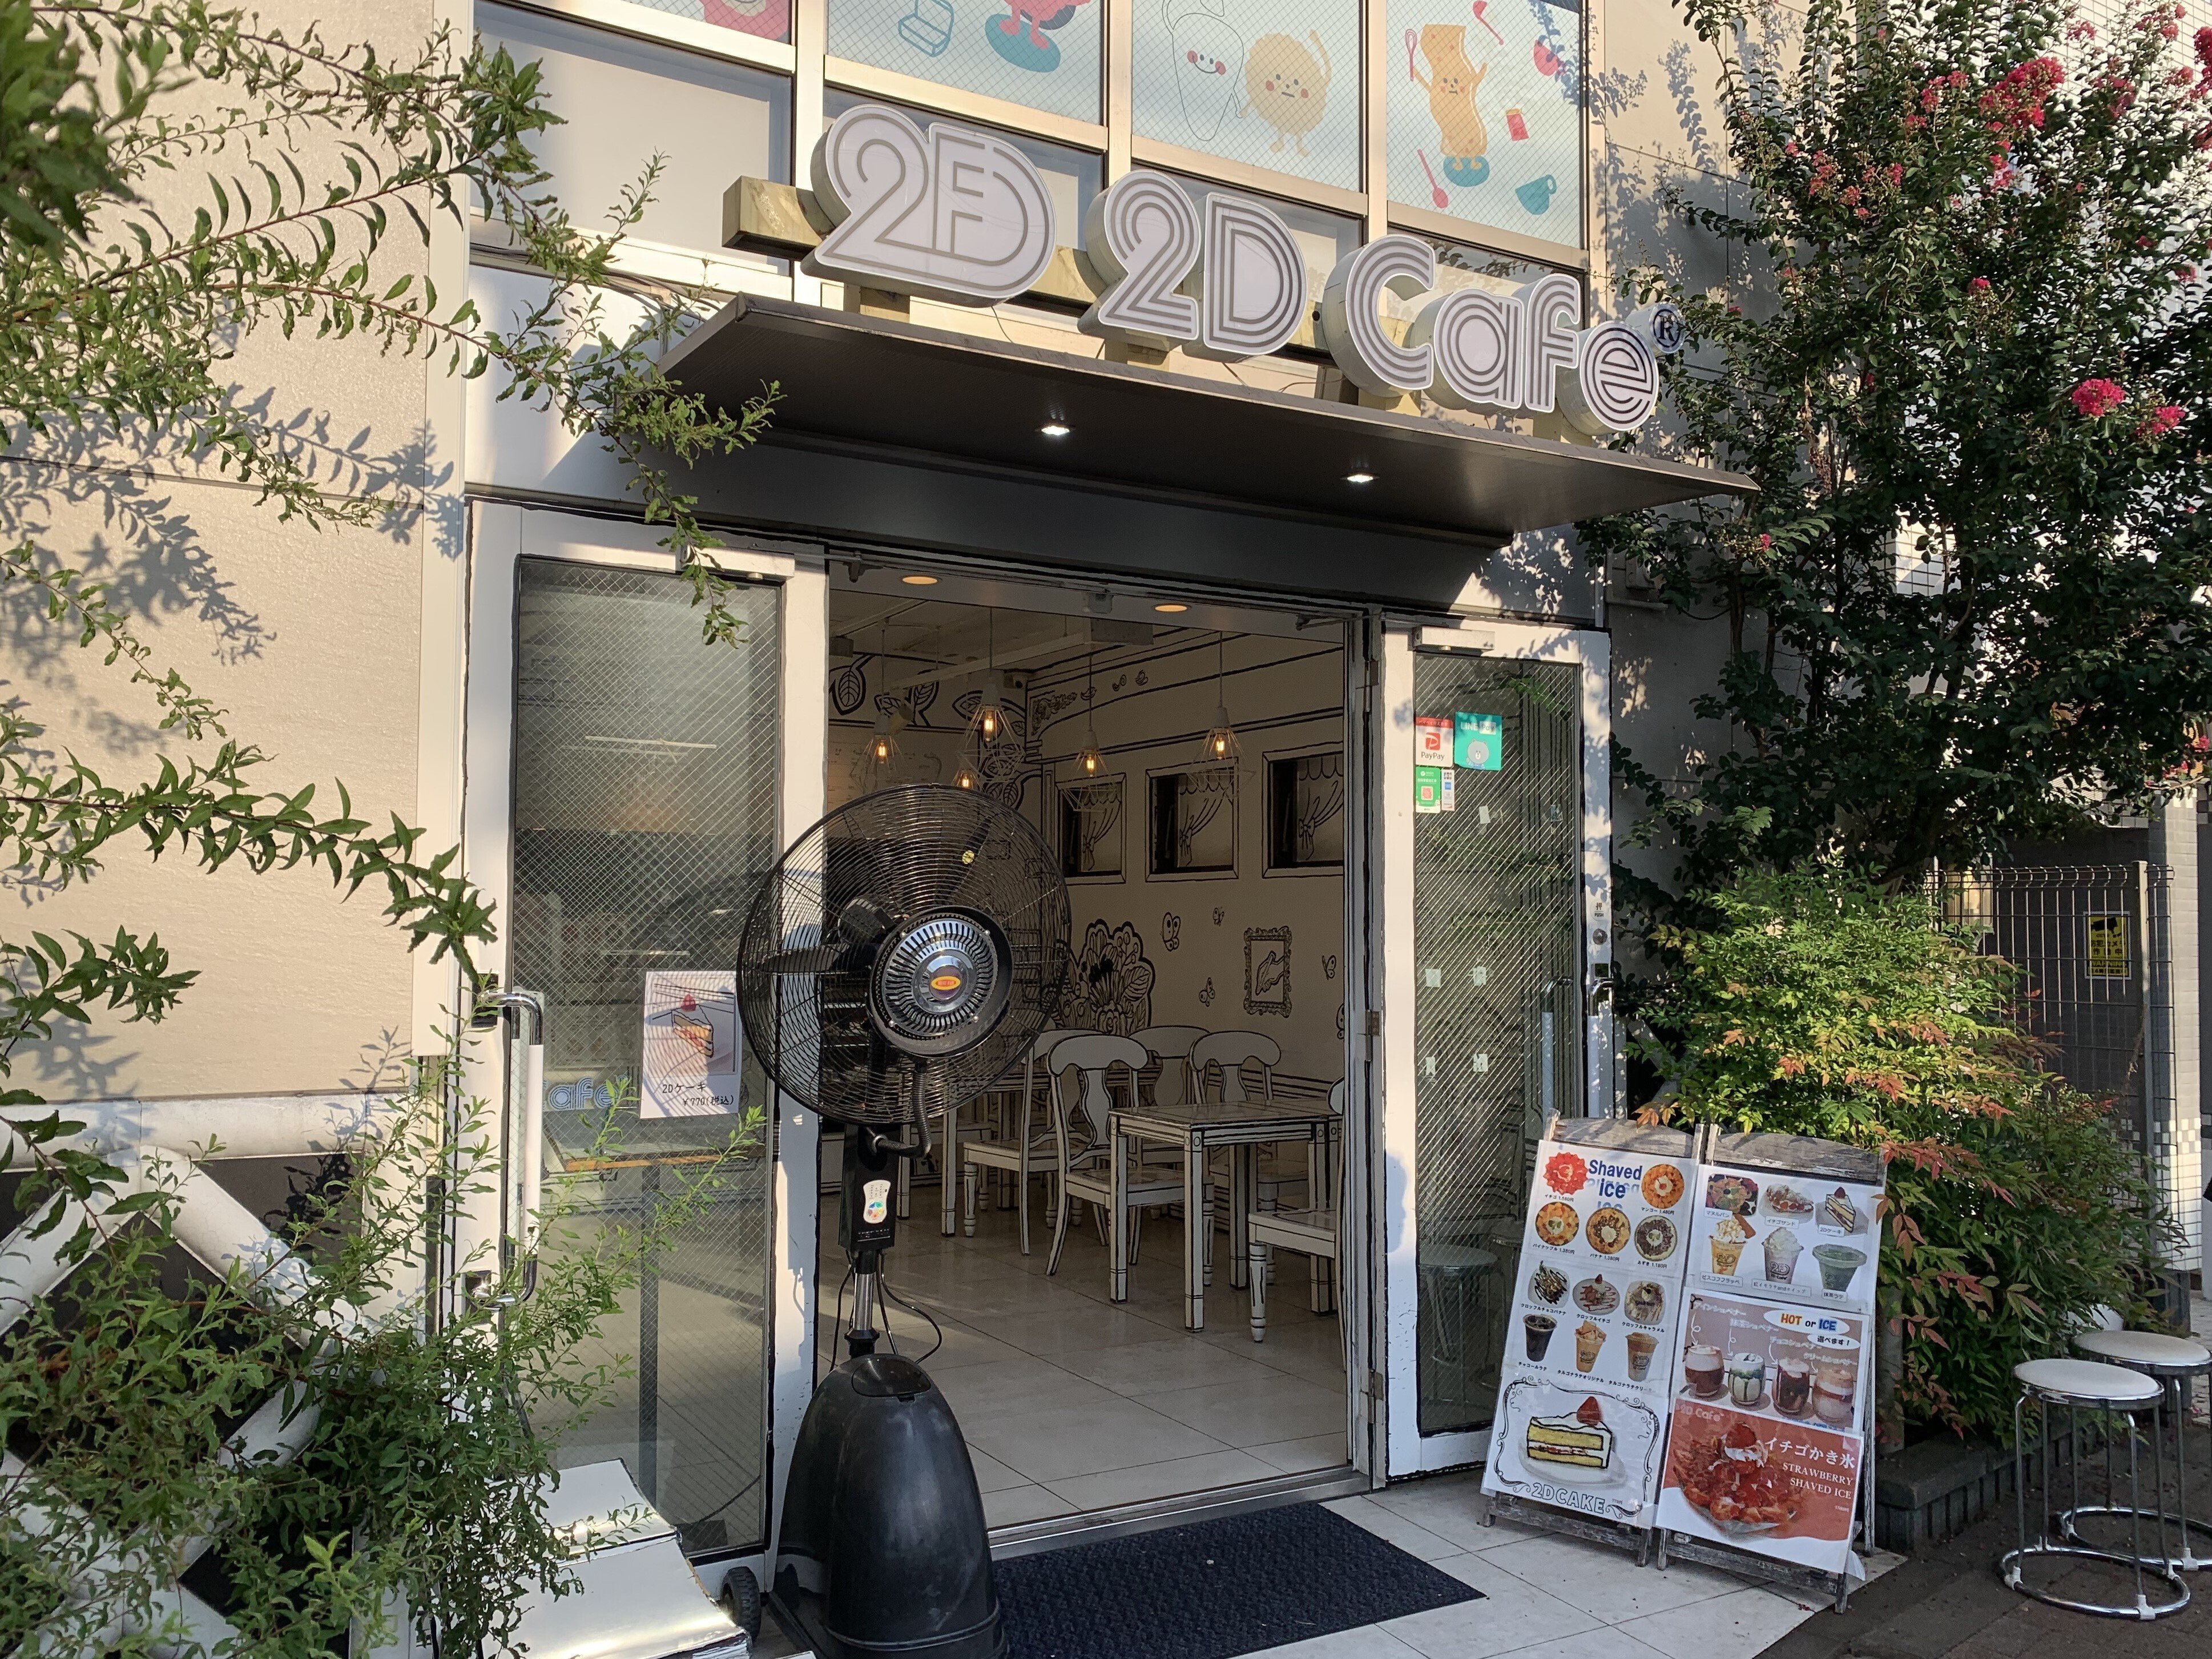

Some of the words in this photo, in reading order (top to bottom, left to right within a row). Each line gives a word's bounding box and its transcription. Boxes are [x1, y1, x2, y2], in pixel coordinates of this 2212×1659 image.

[1098, 169, 1307, 355] 2D
[1345, 235, 1659, 432] Cafe
[1421, 751, 1445, 761] PayPay
[542, 1076, 618, 1111] afe
[662, 1082, 706, 1093] 2Dケーキ
[1588, 1159, 1643, 1180] Shaved
[1599, 1178, 1626, 1199] ice
[1780, 1313, 1802, 1326] HOT
[1818, 1319, 1837, 1331] ICE
[1765, 1437, 1856, 1469] イチゴかき氷
[1782, 1463, 1854, 1486] STRAWBERRY
[1790, 1477, 1831, 1494] SHAVED
[1834, 1488, 1851, 1500] ICE
